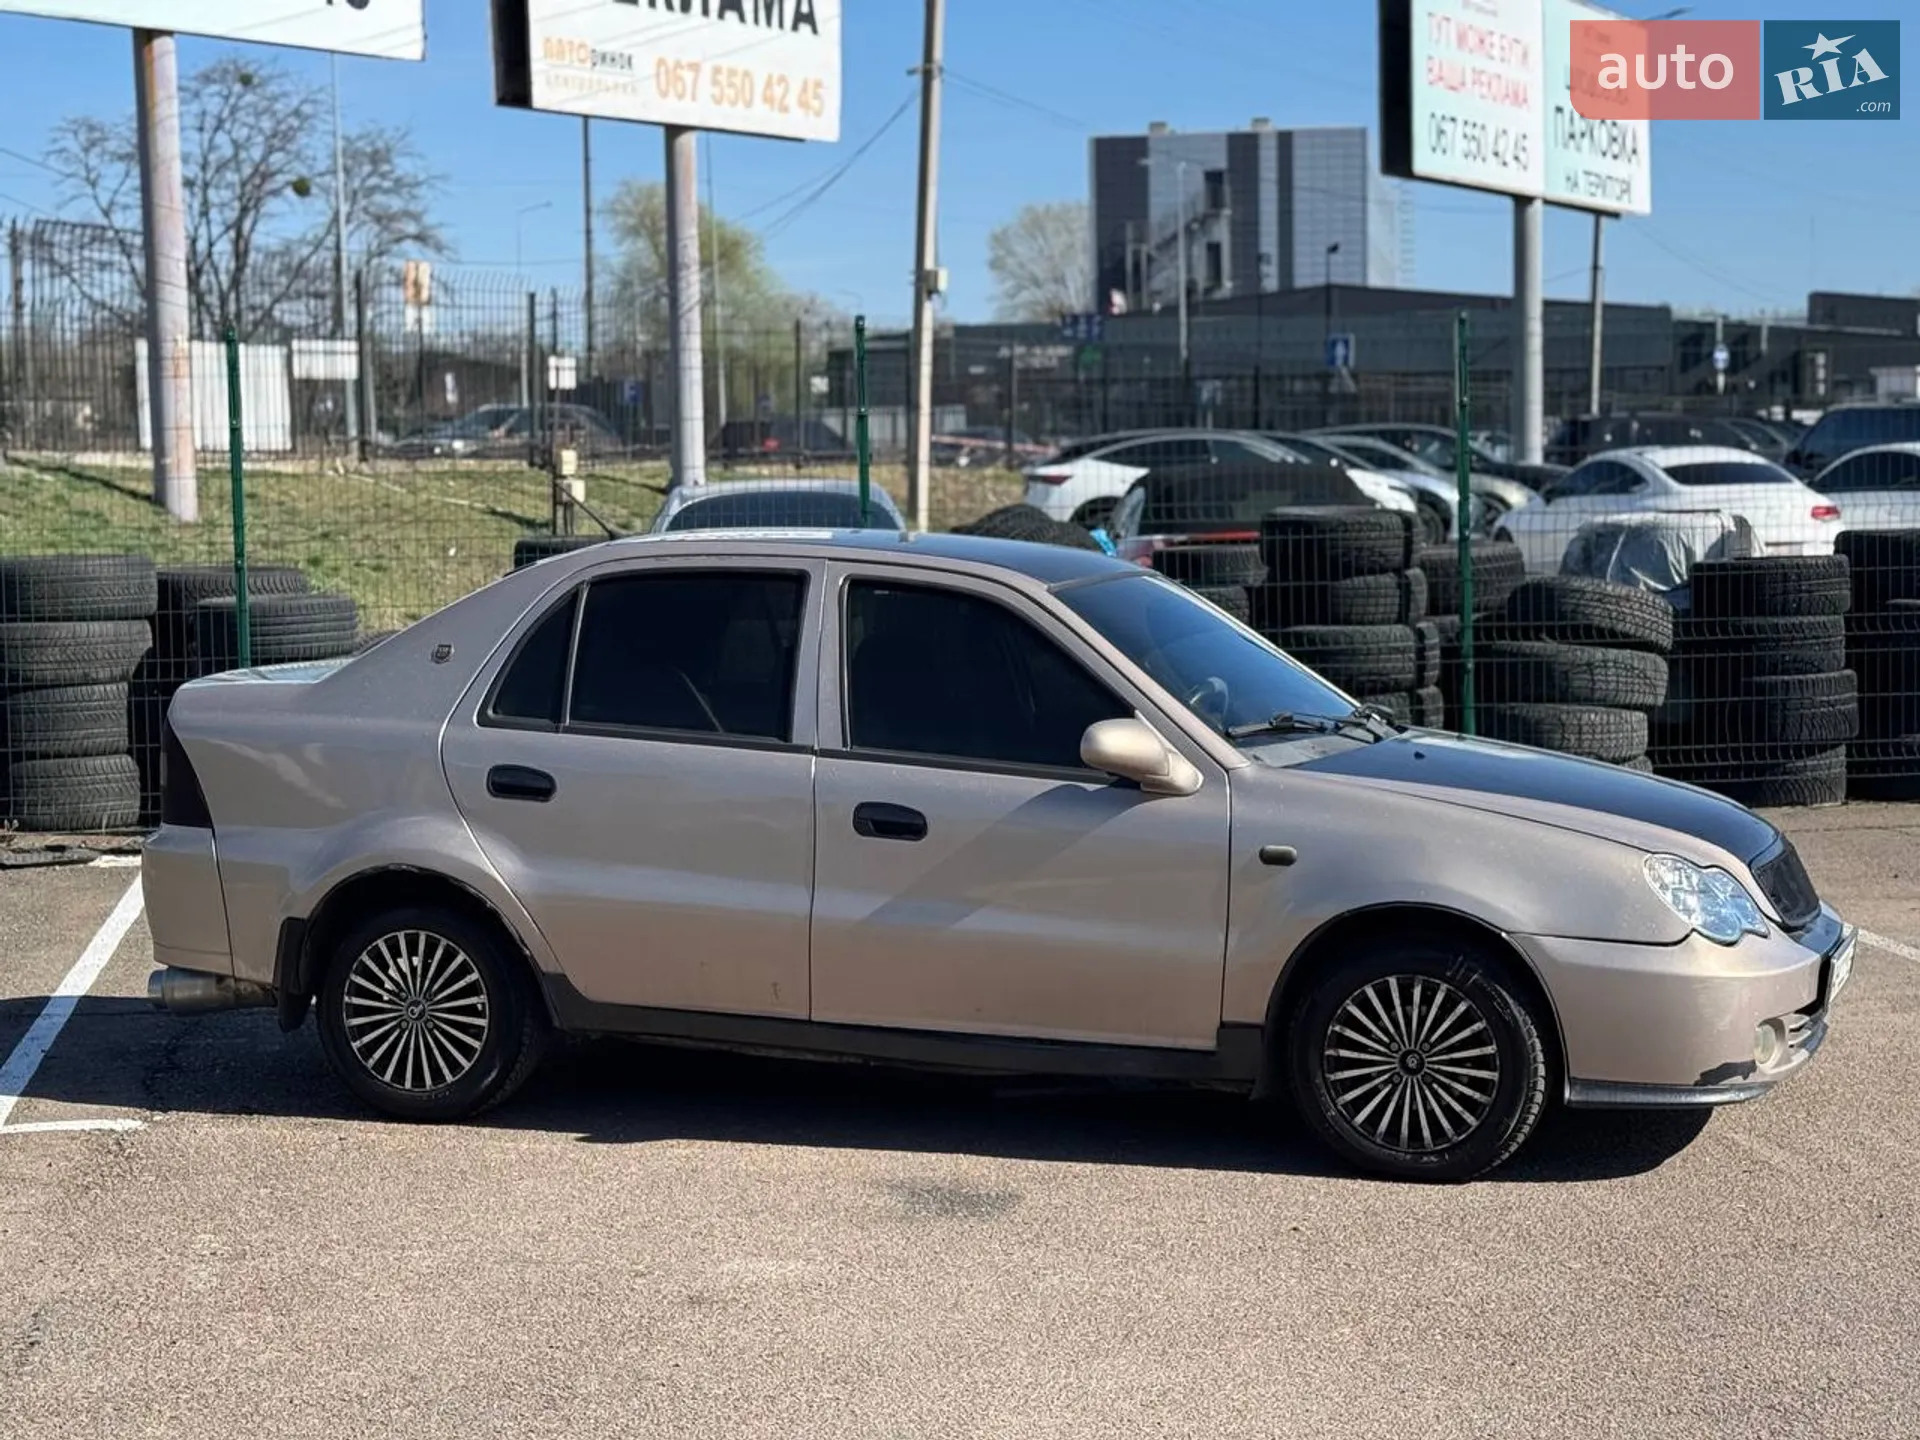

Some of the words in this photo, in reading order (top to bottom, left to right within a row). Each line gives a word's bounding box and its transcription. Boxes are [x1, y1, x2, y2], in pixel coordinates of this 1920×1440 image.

[655, 56, 700, 102] 067
[710, 64, 754, 110] 550
[762, 72, 791, 114] 42
[797, 76, 825, 119] 45
[1428, 111, 1458, 157] 067
[1462, 118, 1489, 163] 550
[1492, 126, 1510, 168] 42
[1512, 131, 1530, 173] 45
[1554, 105, 1641, 167] ПАРКОВКА
